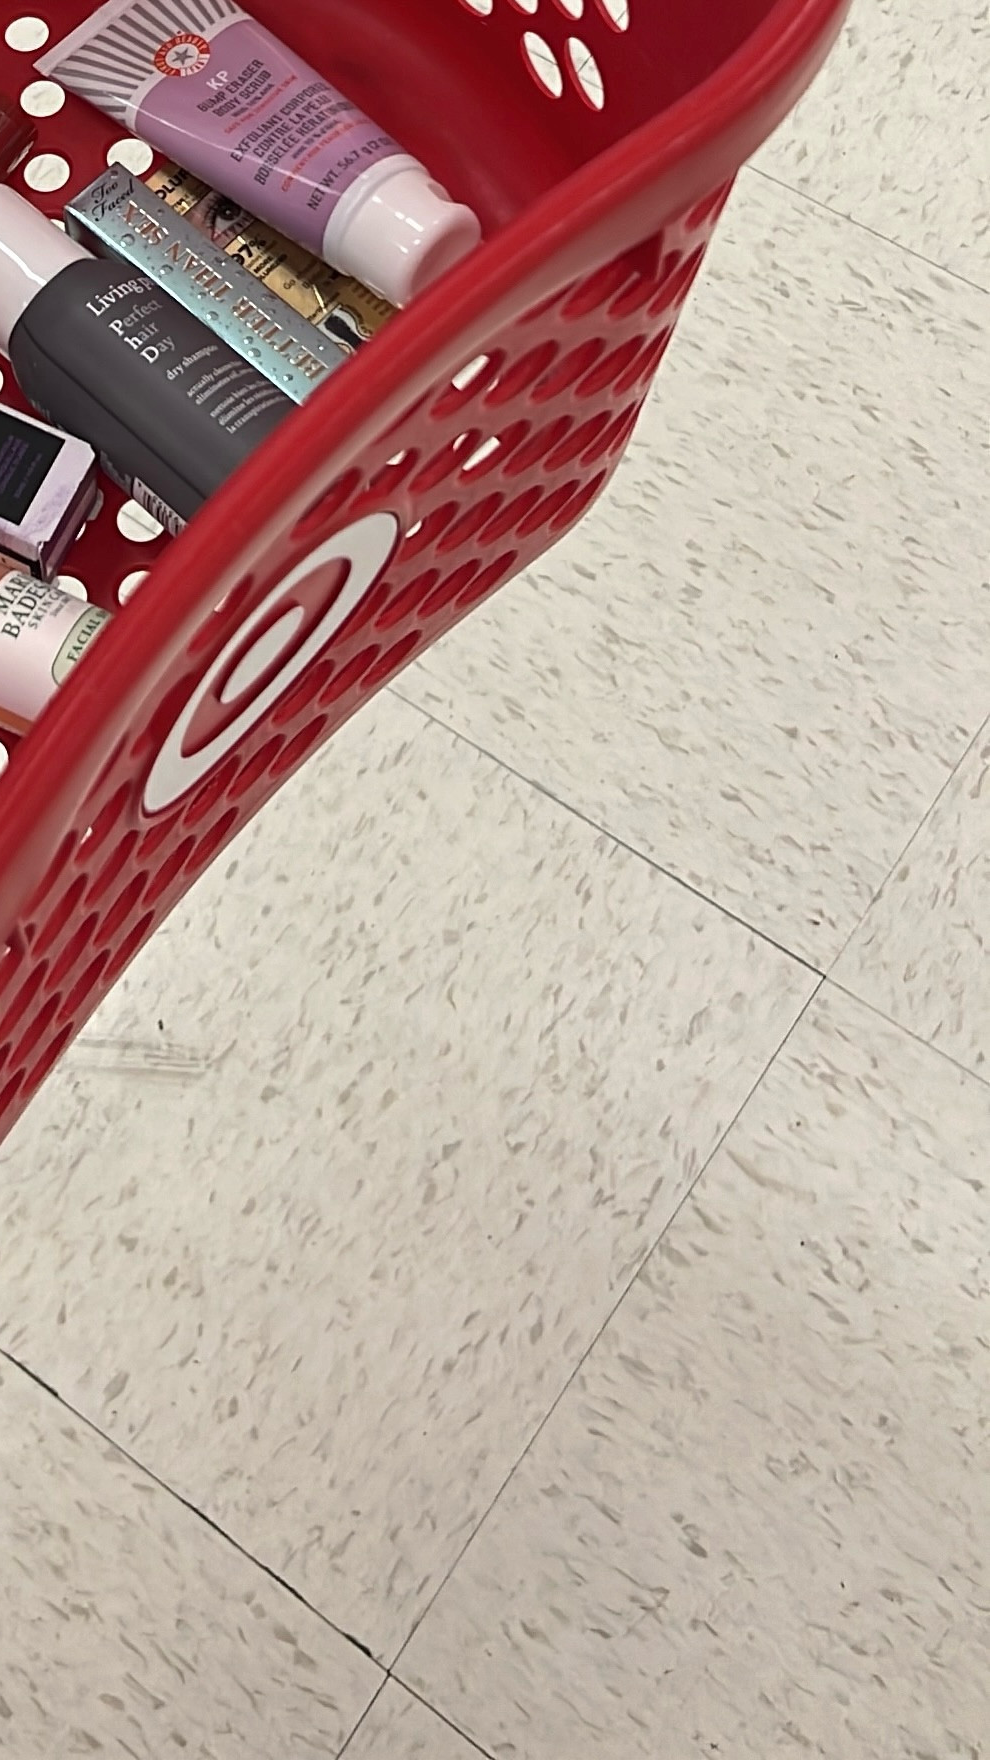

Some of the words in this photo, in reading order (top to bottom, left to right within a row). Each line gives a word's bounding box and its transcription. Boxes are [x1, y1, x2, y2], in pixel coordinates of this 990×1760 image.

[197, 91, 228, 112] BUMP
[225, 59, 264, 94] ERASER
[206, 70, 229, 90] KP
[212, 96, 242, 117] BODY
[239, 69, 272, 99] SCRUB
[230, 114, 283, 162] EXFOLIANT
[253, 121, 293, 158] CONTRE
[289, 109, 308, 125] LA
[91, 179, 119, 204] Too
[91, 178, 135, 222] Faced
[306, 187, 326, 211] NET
[336, 149, 361, 171] 56.7
[119, 199, 170, 246] SEX
[164, 240, 234, 301] THAN
[85, 278, 144, 317] Living
[108, 298, 163, 337] Perfect
[123, 321, 160, 351] hair
[139, 334, 176, 365] Day
[232, 295, 329, 381] BETTER
[165, 362, 185, 381] dry
[66, 618, 101, 662] FACIAL
